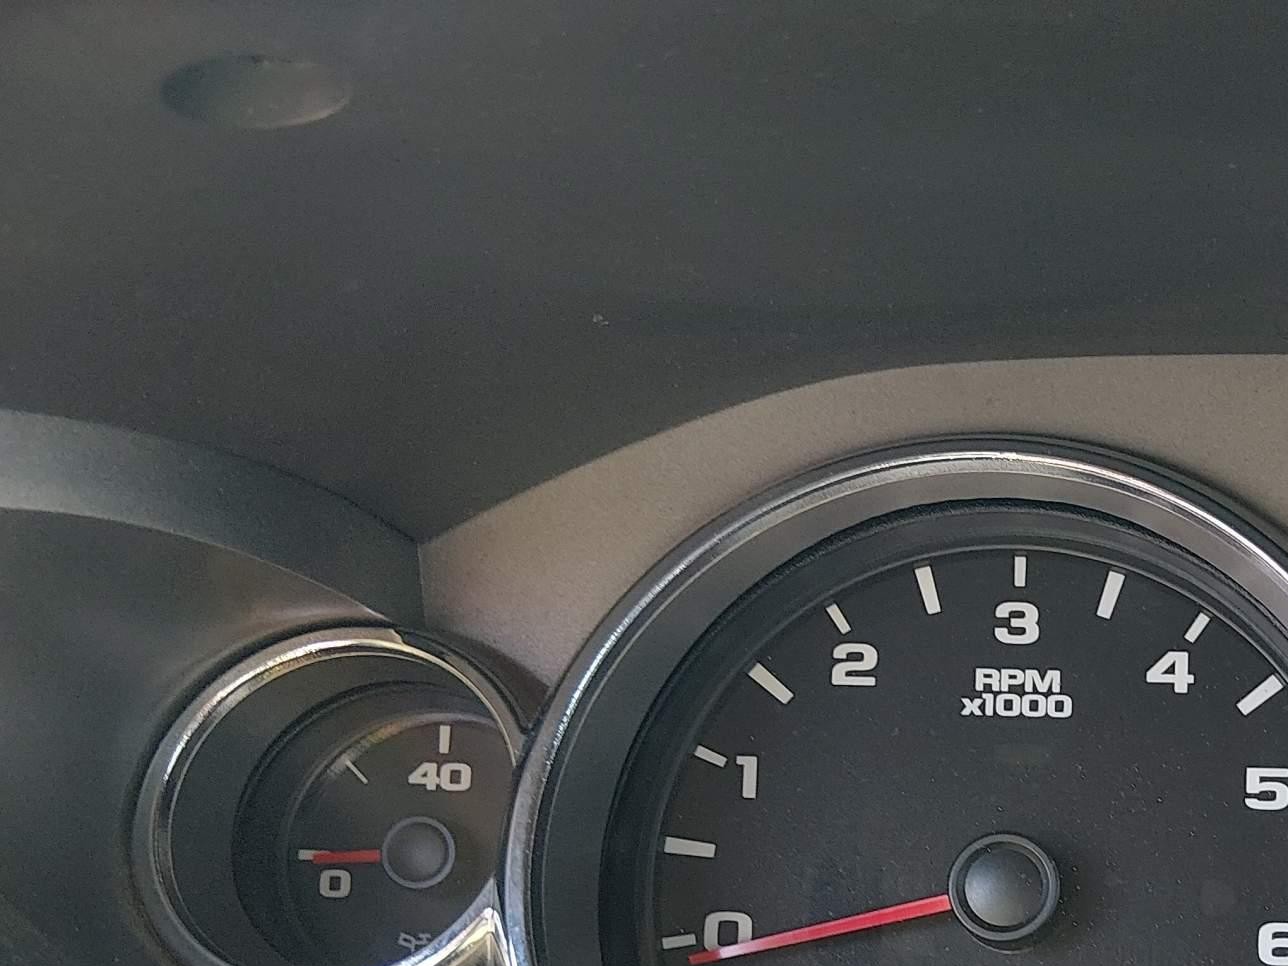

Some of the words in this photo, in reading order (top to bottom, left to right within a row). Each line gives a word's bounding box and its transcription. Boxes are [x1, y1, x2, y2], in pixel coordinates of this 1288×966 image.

[994, 601, 1040, 645] 3
[831, 643, 880, 688] 2
[974, 667, 1061, 693] RPM
[1146, 651, 1196, 694] 4
[960, 692, 1074, 719] x1000
[407, 762, 472, 792] 40
[735, 755, 758, 799] 1
[319, 869, 352, 898] 0
[703, 911, 753, 953] 0
